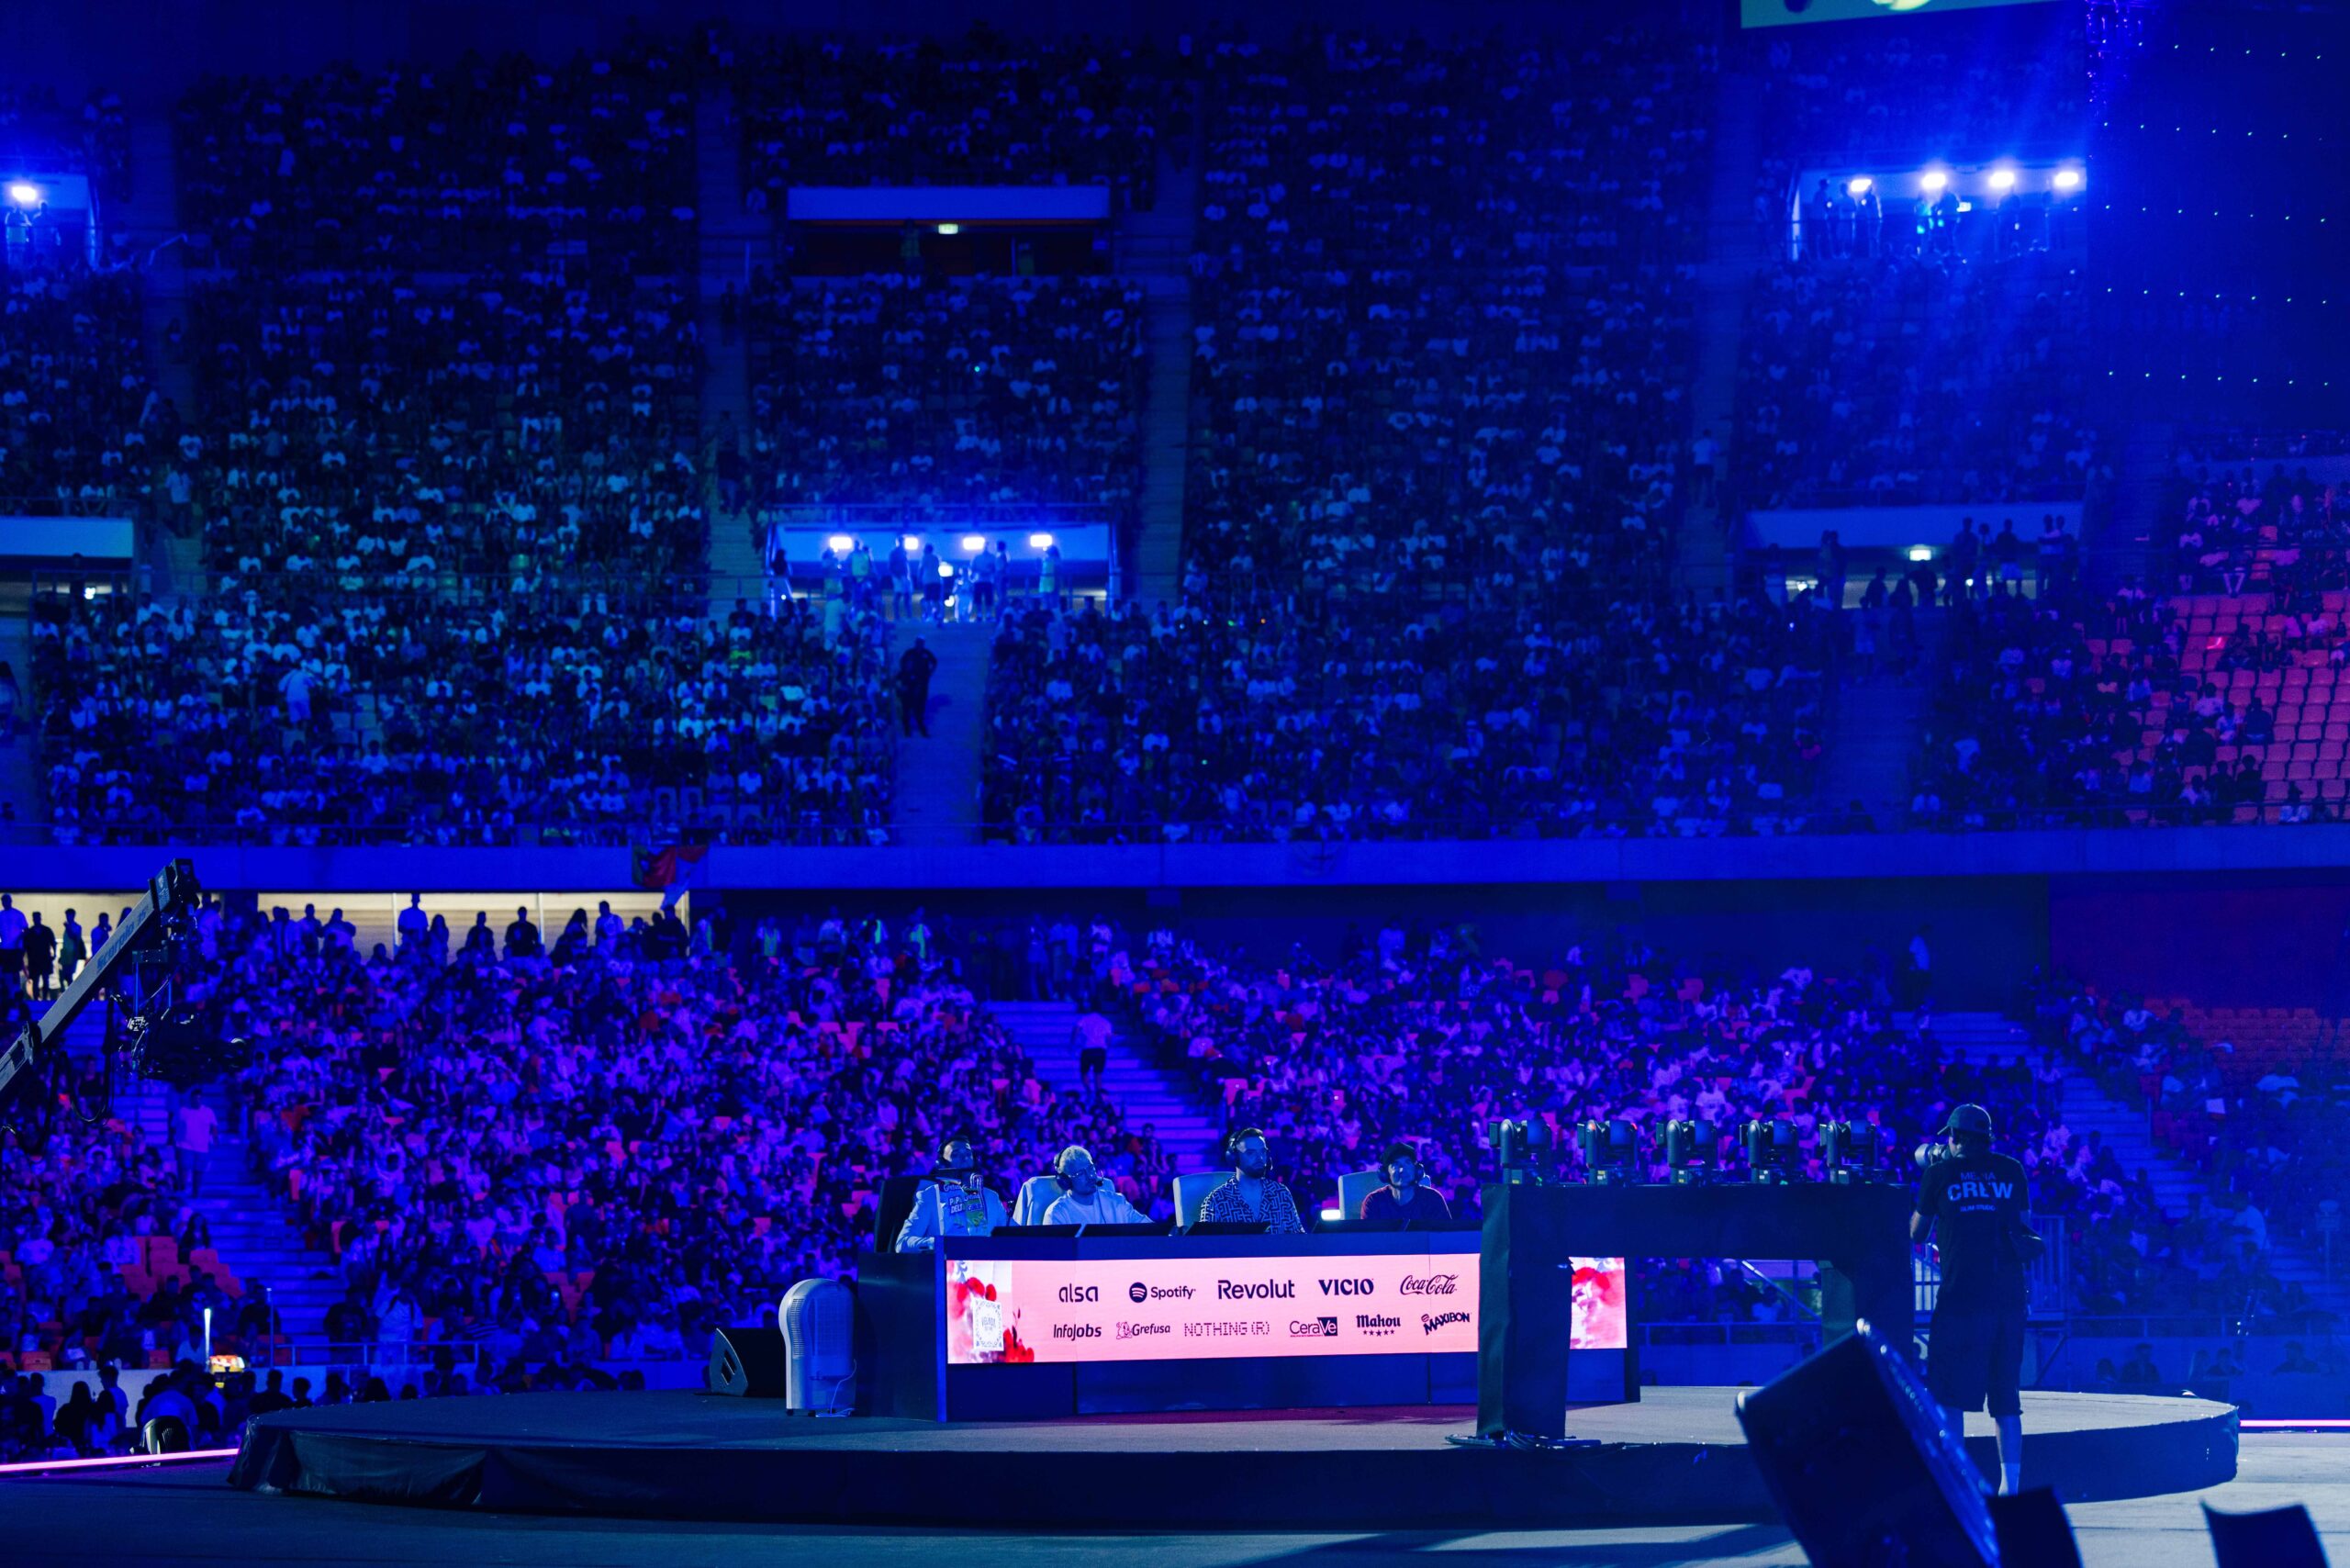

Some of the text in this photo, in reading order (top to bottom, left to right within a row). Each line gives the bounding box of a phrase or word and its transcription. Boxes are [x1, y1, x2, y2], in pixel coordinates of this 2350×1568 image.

[1960, 1171, 1997, 1182] MEIA
[1947, 1181, 2013, 1202] CREW
[1058, 1283, 1099, 1303] alsa
[1150, 1285, 1193, 1300] Spotify
[1217, 1279, 1295, 1299] Revolut
[1318, 1279, 1374, 1295] VICIO
[1290, 1317, 1337, 1335] CeraVe
[1356, 1314, 1401, 1328] Mahou
[1423, 1312, 1470, 1336] MAXIBON
[1053, 1324, 1102, 1341] InfoJobs
[1132, 1323, 1170, 1337] Grefusa
[1184, 1322, 1248, 1337] NOTHING
